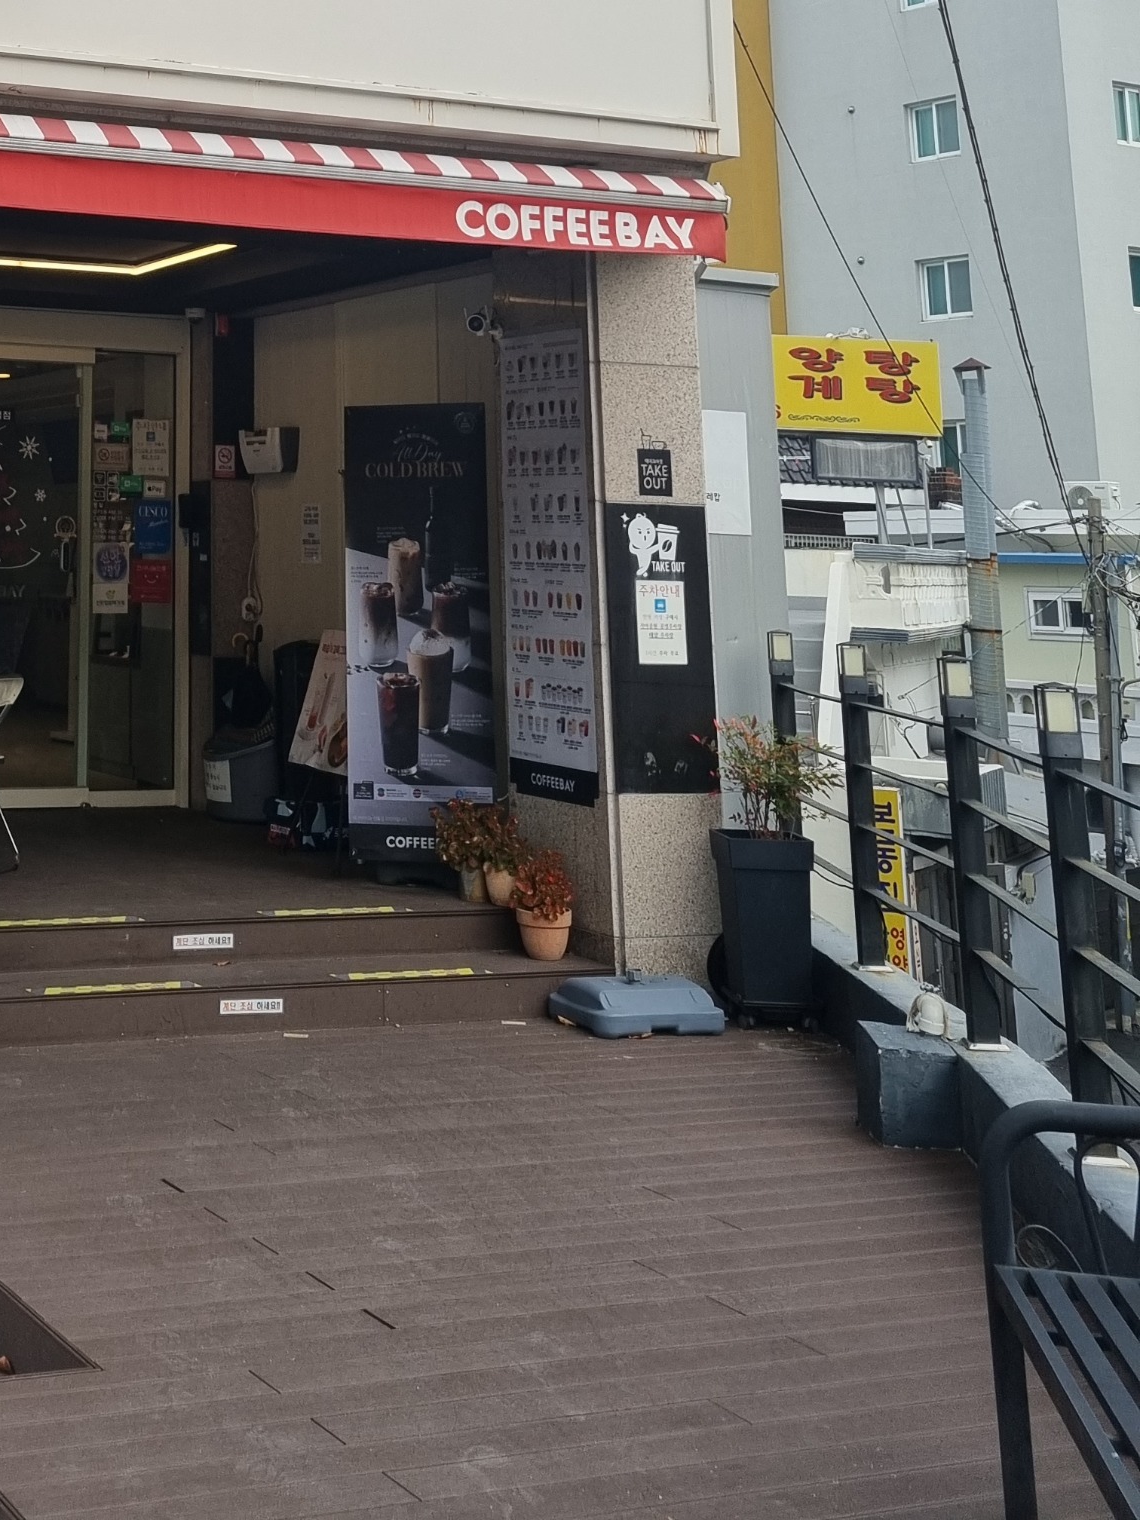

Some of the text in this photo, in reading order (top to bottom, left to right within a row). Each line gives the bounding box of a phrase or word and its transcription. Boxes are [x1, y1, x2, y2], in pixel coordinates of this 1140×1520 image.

[455, 200, 695, 250] COFFEEBAY
[365, 461, 466, 478] COLD BREW
[641, 464, 669, 477] TAKE
[643, 477, 668, 489] OUT
[651, 560, 686, 573] TAKE OUT
[638, 584, 680, 598] 주차안내
[531, 772, 575, 793] COFFEEBAY
[193, 937, 205, 946] 조심
[240, 1001, 253, 1011] 조심
